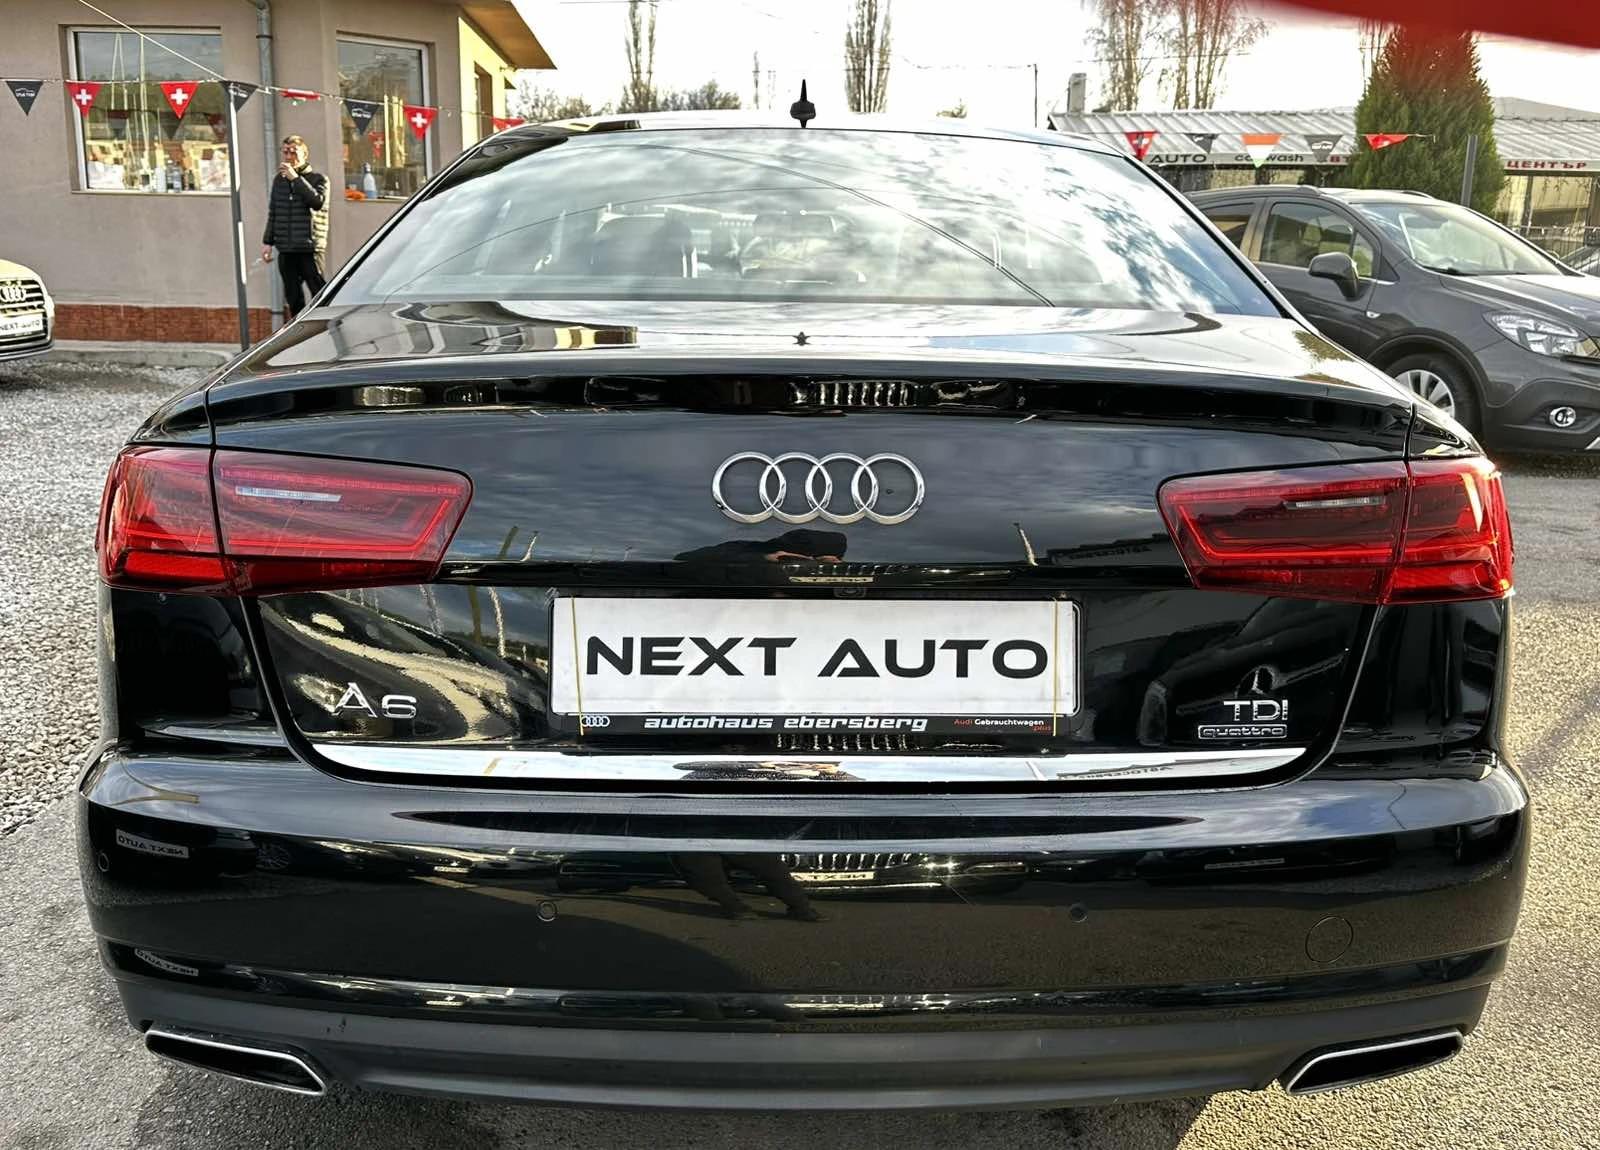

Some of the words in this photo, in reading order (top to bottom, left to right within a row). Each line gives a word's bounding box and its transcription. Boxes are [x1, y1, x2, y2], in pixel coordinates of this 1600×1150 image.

[1150, 154, 1207, 163] AUTO
[1507, 160, 1587, 168] ЦЕНТЪР
[586, 636, 797, 676] NEXT
[817, 638, 1048, 679] AUTO
[331, 682, 418, 719] A6
[1223, 699, 1288, 721] TDI
[644, 716, 774, 729] autohaus
[784, 716, 928, 732] ebersberg
[974, 718, 1045, 727] Gebrauchtwagen
[1202, 727, 1285, 738] quattro
